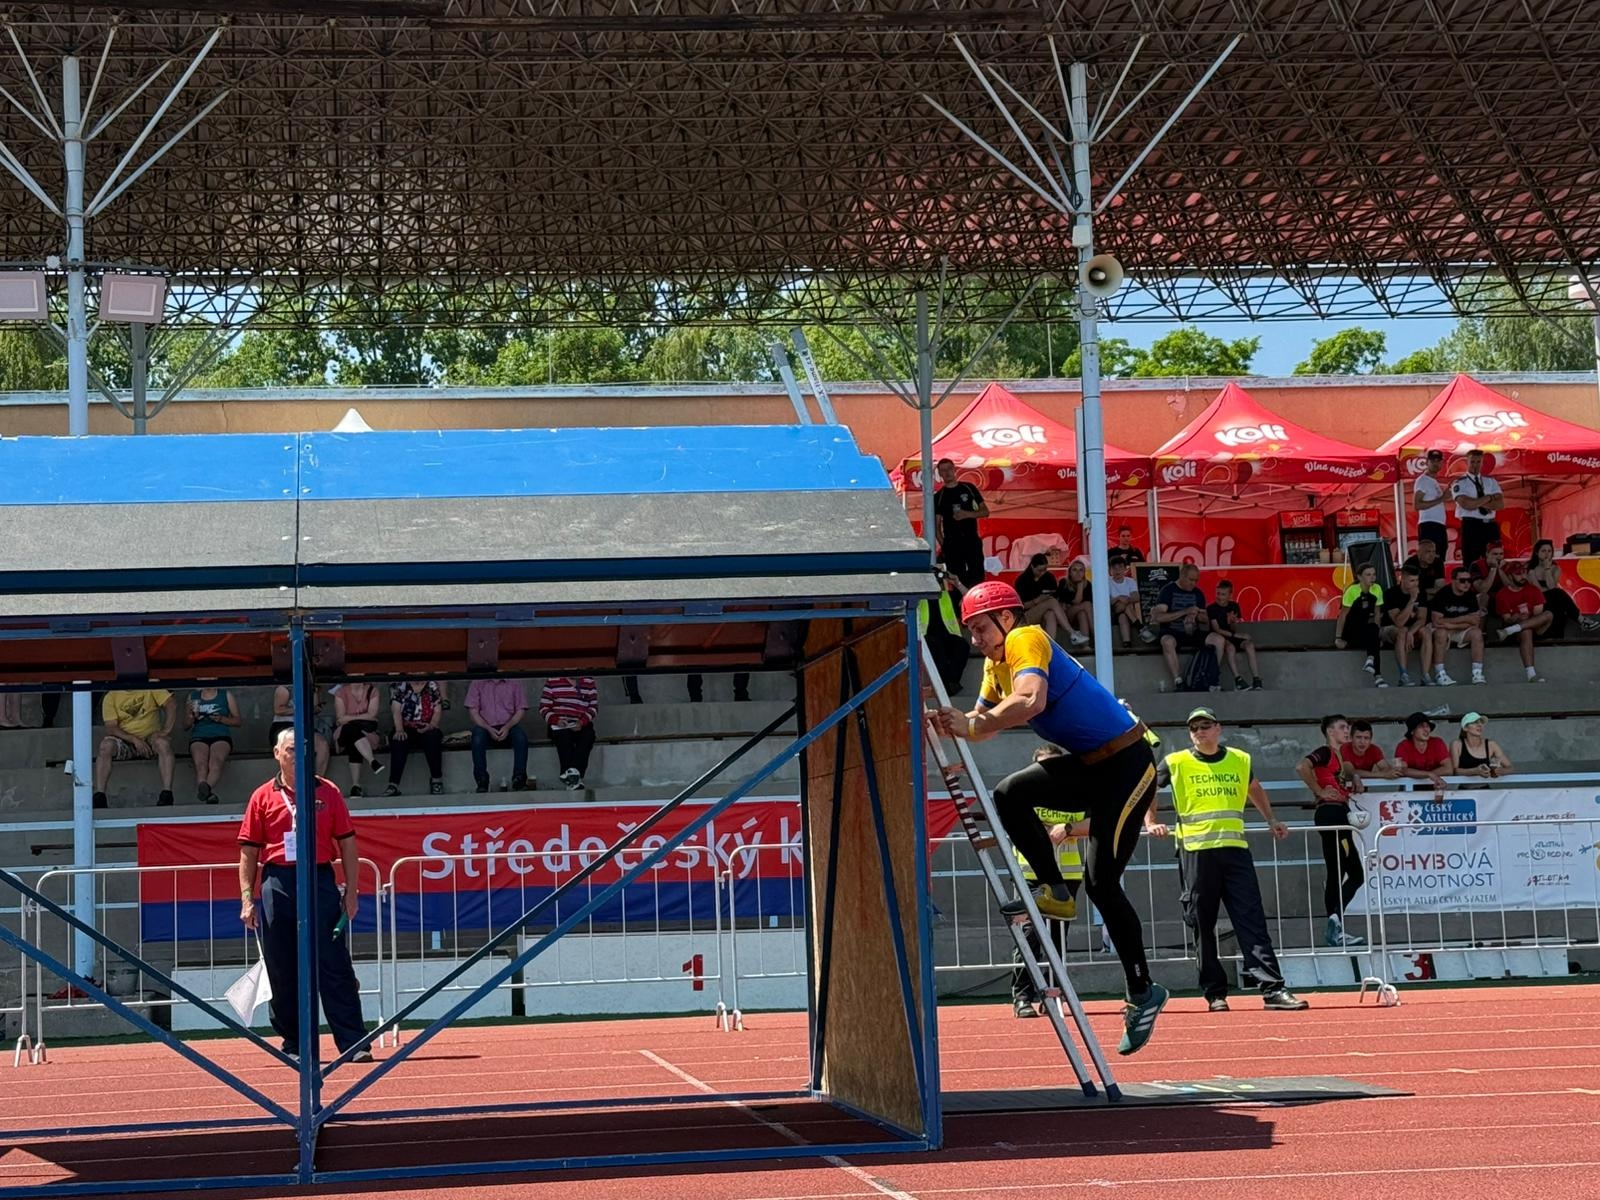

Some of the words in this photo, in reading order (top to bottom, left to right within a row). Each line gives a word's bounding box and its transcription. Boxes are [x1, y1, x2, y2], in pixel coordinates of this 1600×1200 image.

[1196, 787, 1238, 797] SKUPINA
[1424, 801, 1453, 812] ČESKÝ
[1425, 811, 1474, 822] ATLETICKÝ
[422, 816, 763, 880] Středočeský
[682, 954, 704, 991] 1
[1403, 953, 1434, 980] 3
